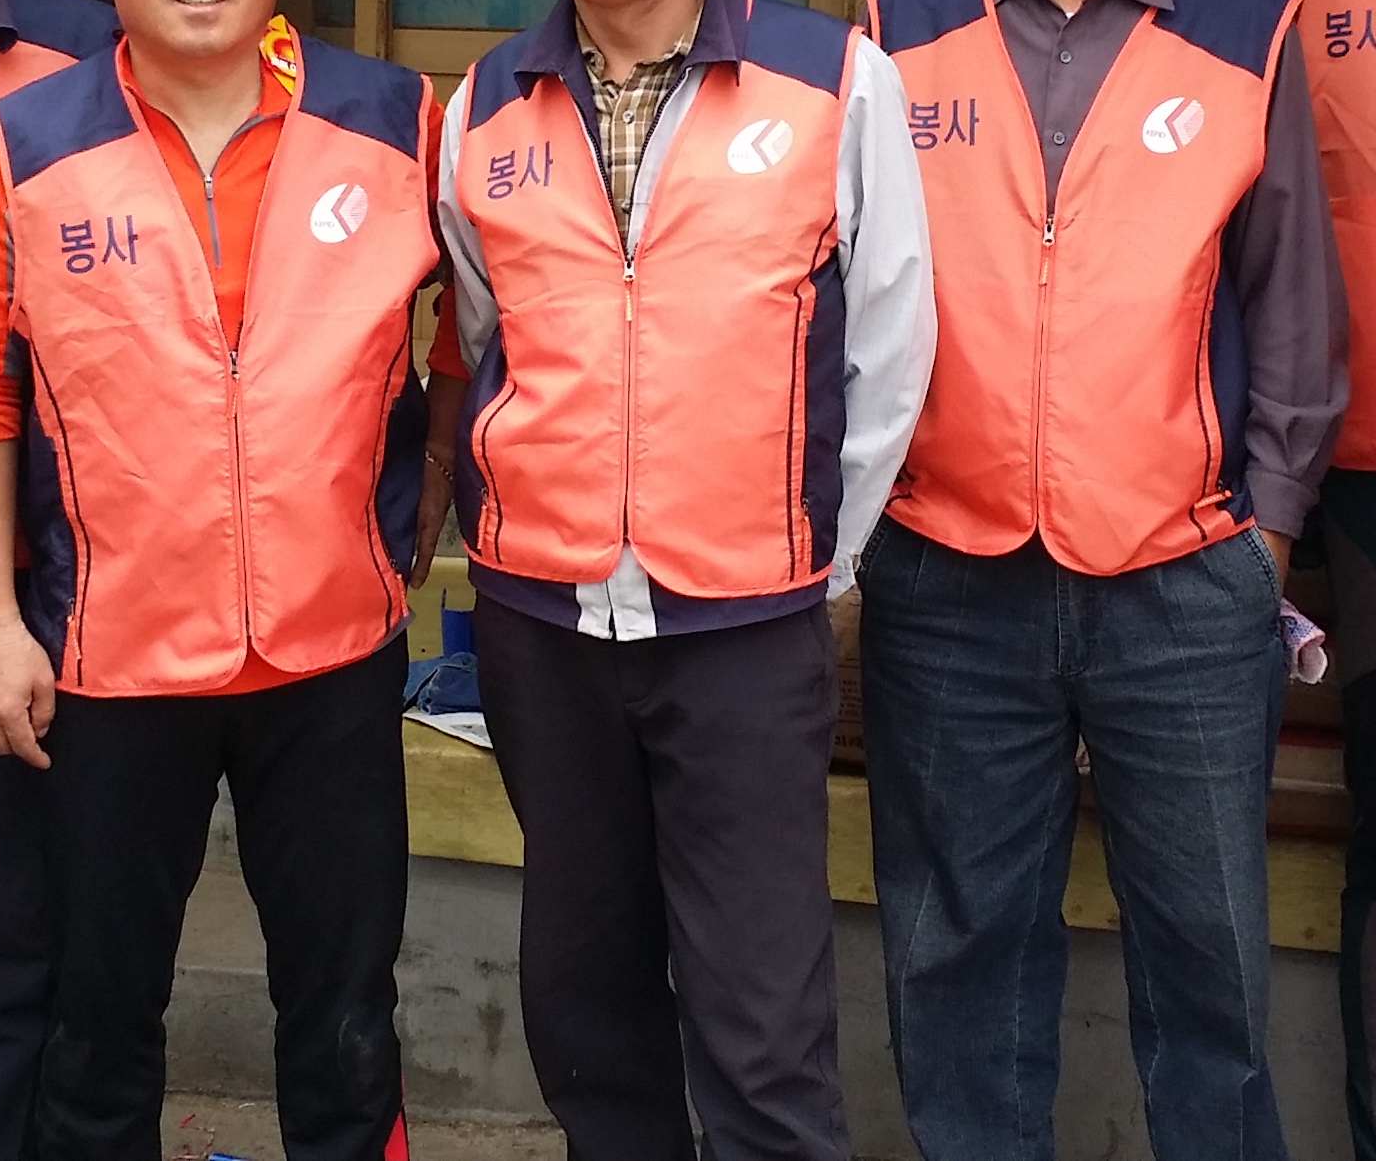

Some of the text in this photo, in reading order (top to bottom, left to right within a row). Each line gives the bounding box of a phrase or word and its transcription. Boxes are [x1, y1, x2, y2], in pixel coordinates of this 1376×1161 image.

[907, 97, 981, 152] 봉사
[485, 139, 555, 200] 봉사
[59, 214, 140, 275] 봉사
